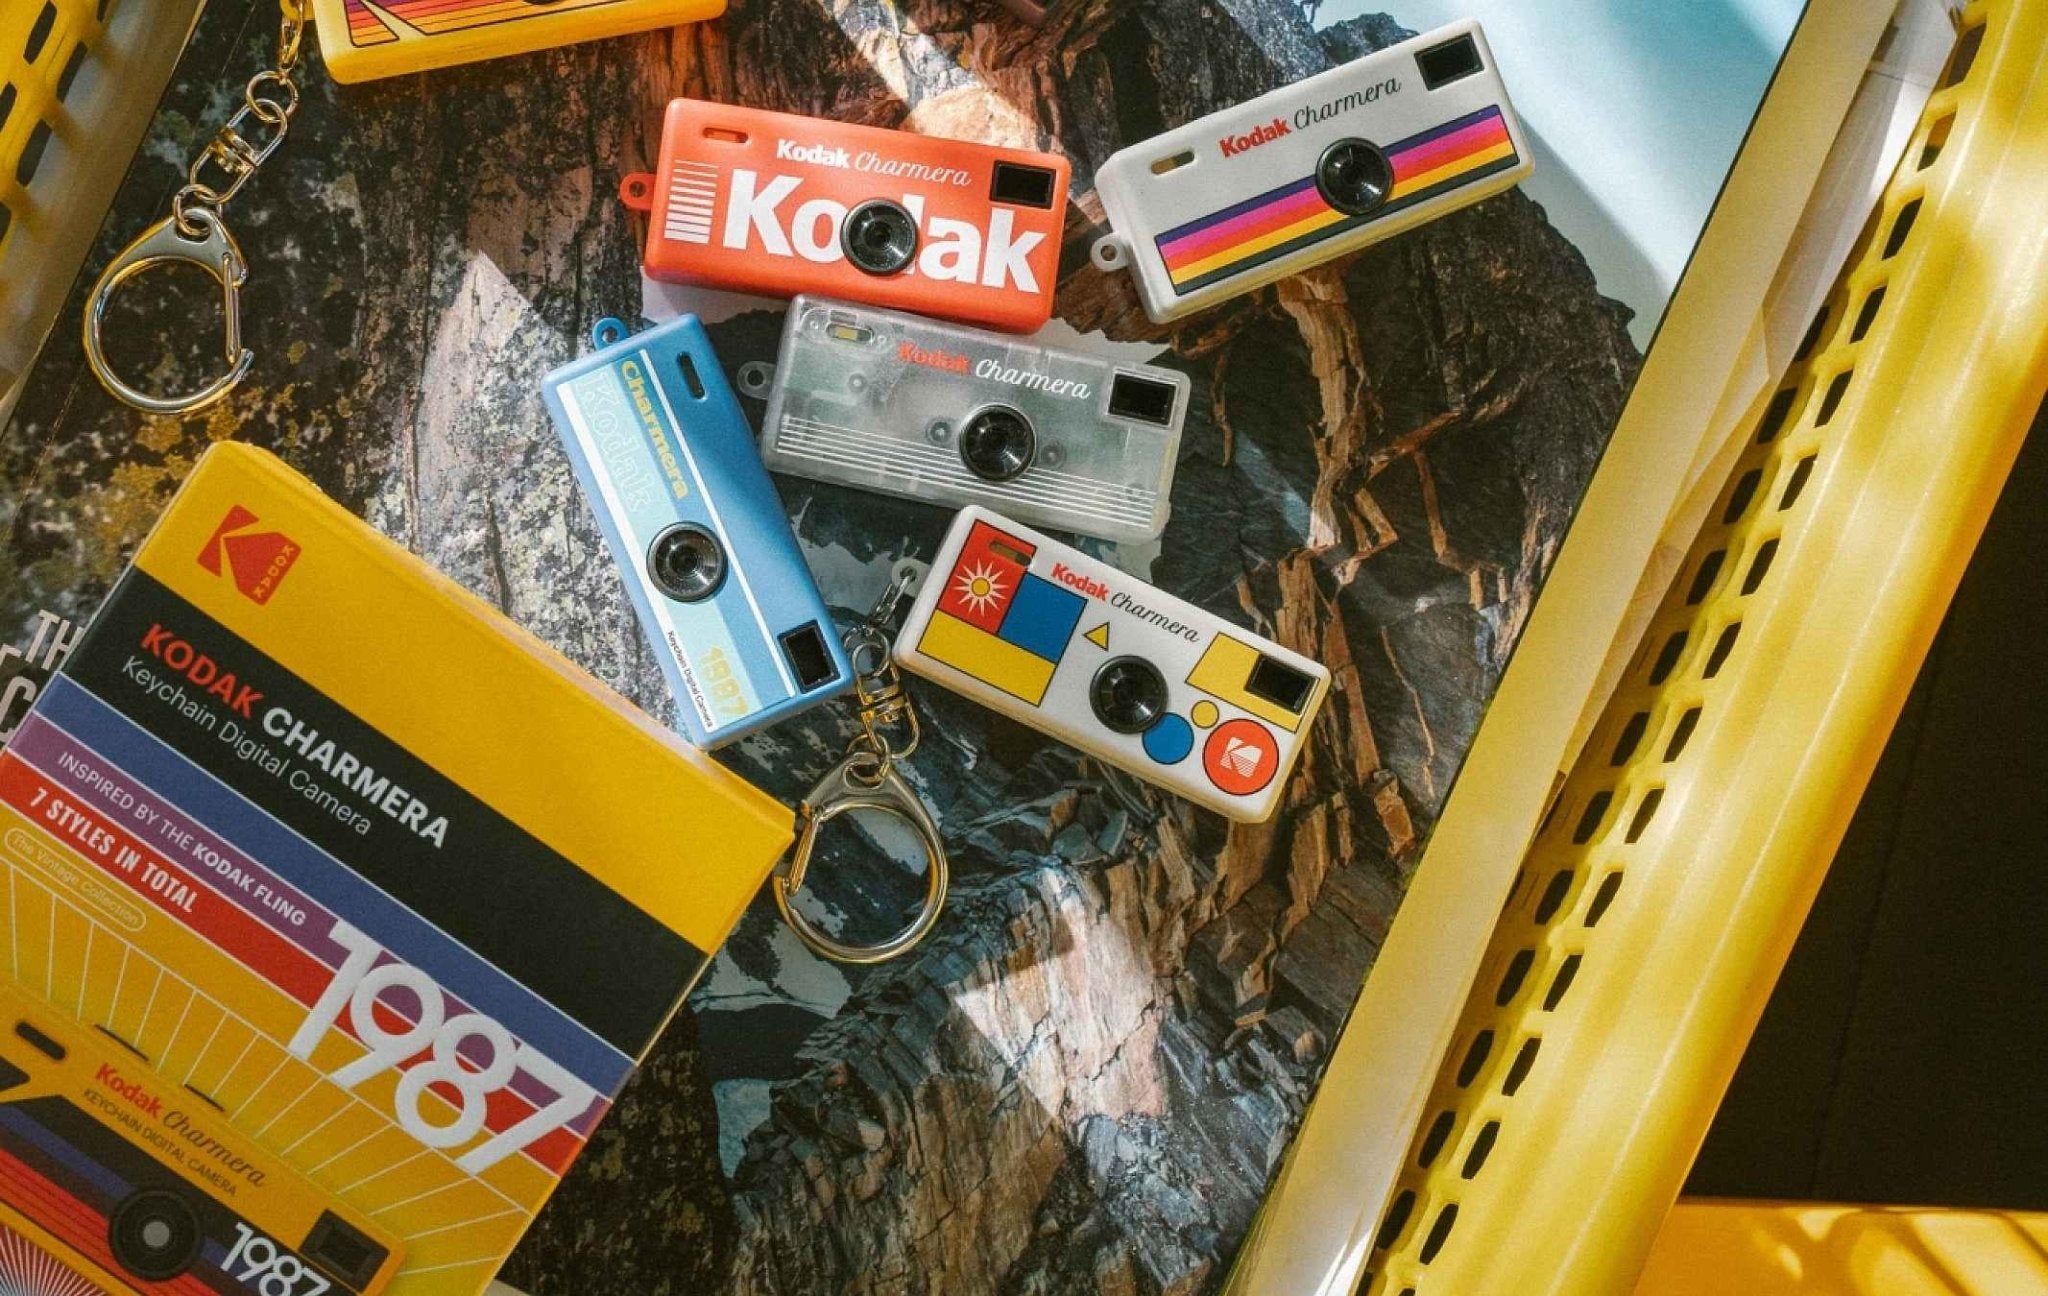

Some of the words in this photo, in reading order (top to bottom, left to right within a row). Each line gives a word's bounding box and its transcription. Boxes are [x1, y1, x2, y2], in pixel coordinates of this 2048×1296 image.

[777, 139, 850, 168] Kodak
[855, 152, 972, 187] Charmera
[1219, 118, 1293, 159] Kodak
[1293, 77, 1402, 132] Charmera
[898, 342, 971, 375] Kodak
[975, 358, 1091, 401] Charmera
[575, 372, 654, 513] Kodak
[621, 360, 688, 500] Charmera
[253, 545, 295, 598] KODAK
[1050, 562, 1110, 602] Kodak
[1111, 590, 1200, 643] Charmera
[700, 645, 749, 715] 1987
[122, 655, 217, 732] Keychain
[218, 721, 292, 779] Digital
[289, 769, 373, 836] Camera
[140, 623, 265, 720] KODAK
[262, 706, 450, 849] CHARMERA
[12, 832, 35, 856] The
[36, 846, 80, 888] Vintage
[81, 881, 139, 924] Collection
[29, 787, 48, 808] 7
[45, 798, 117, 856] STYLES
[114, 845, 142, 873] IN
[140, 862, 200, 913] TOTAL
[58, 752, 135, 810] INSPIRED
[133, 803, 160, 826] BY
[160, 819, 194, 850] THE
[192, 843, 258, 893] KODAK
[253, 885, 307, 926] FLING
[287, 919, 598, 1177] 1987
[83, 1087, 142, 1135] KEYCHAIN
[141, 1127, 187, 1165] DIGITAL
[187, 1157, 238, 1198] CAMERA
[95, 1062, 163, 1119] Kodak
[163, 1110, 267, 1188] Charmera
[220, 1221, 331, 1296] 1987
